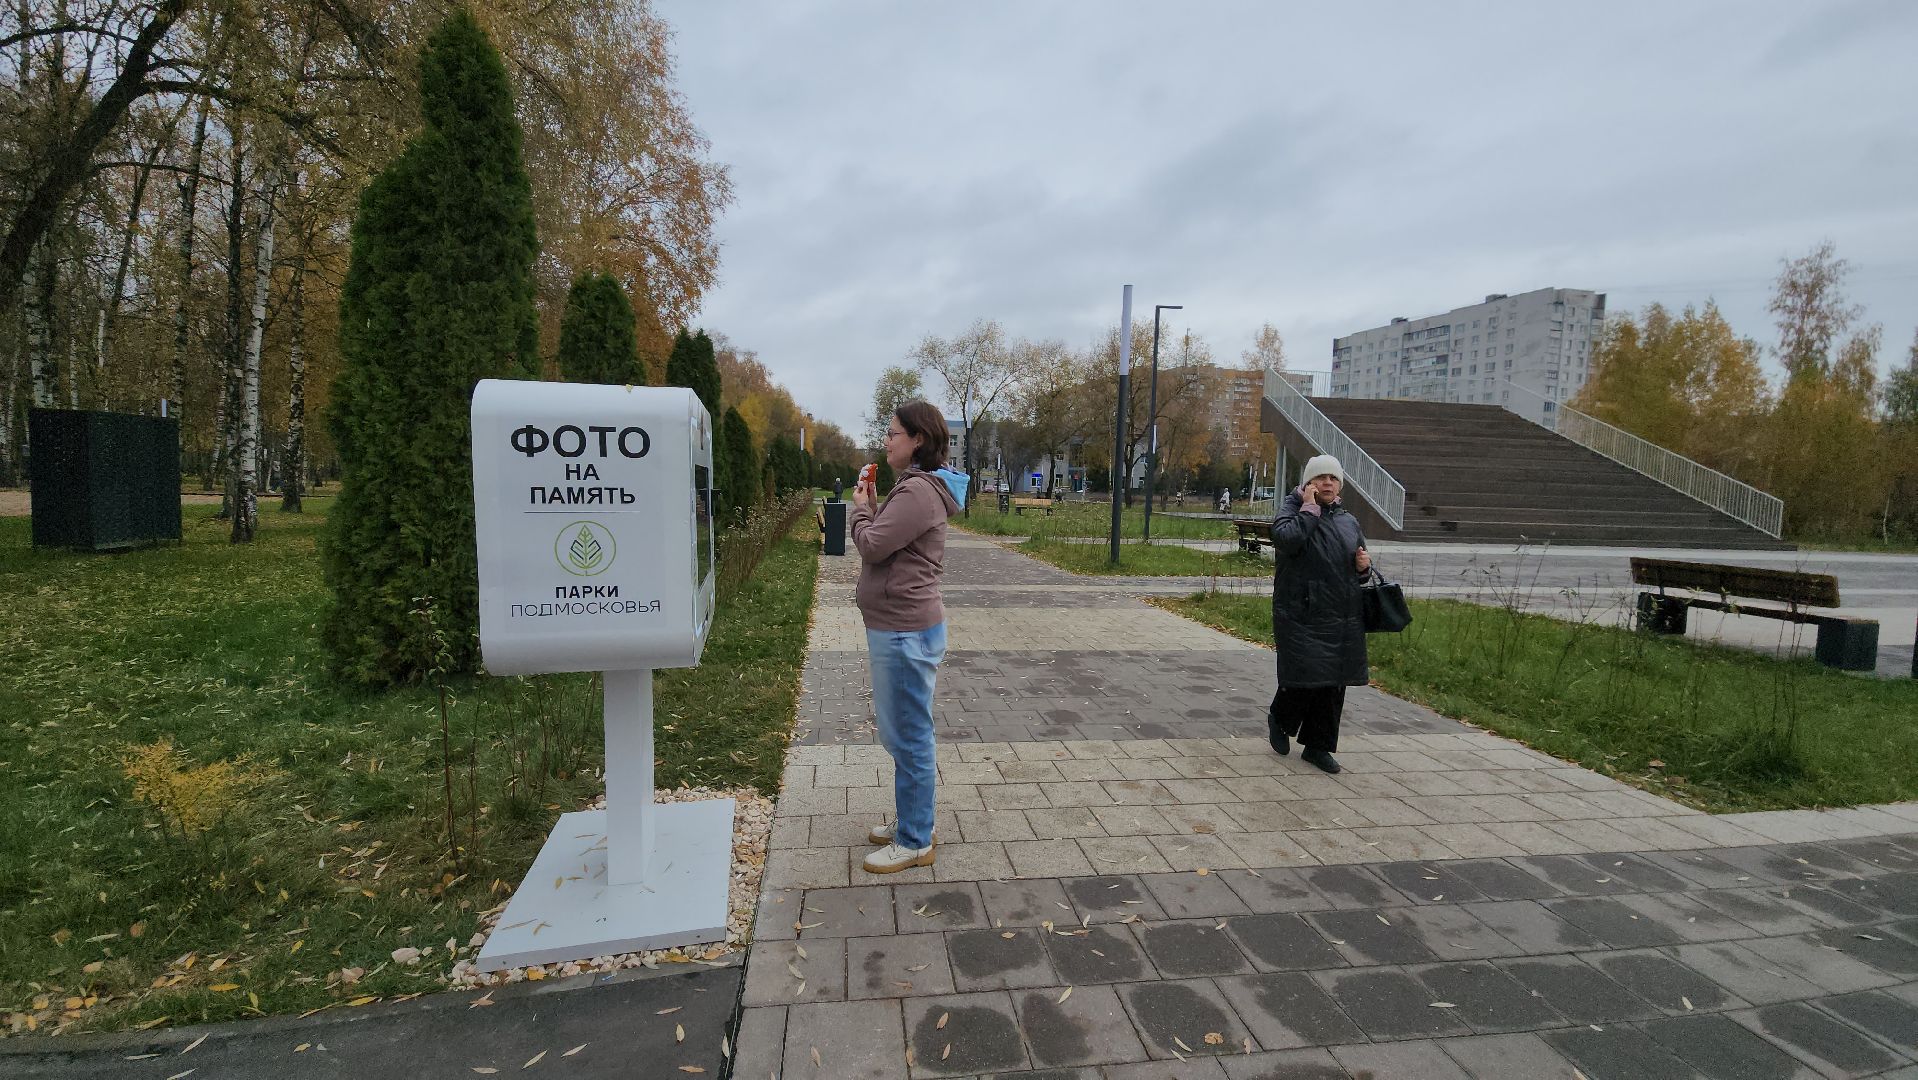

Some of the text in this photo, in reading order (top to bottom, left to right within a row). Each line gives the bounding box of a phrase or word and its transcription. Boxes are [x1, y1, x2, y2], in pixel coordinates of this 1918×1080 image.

[510, 424, 651, 459] ФОТО
[565, 463, 600, 481] НА
[530, 486, 636, 505] ПАМЯТЬ
[555, 585, 619, 599] ПАРКИ
[511, 600, 661, 618] ПОДМОСКОВЬЯ
